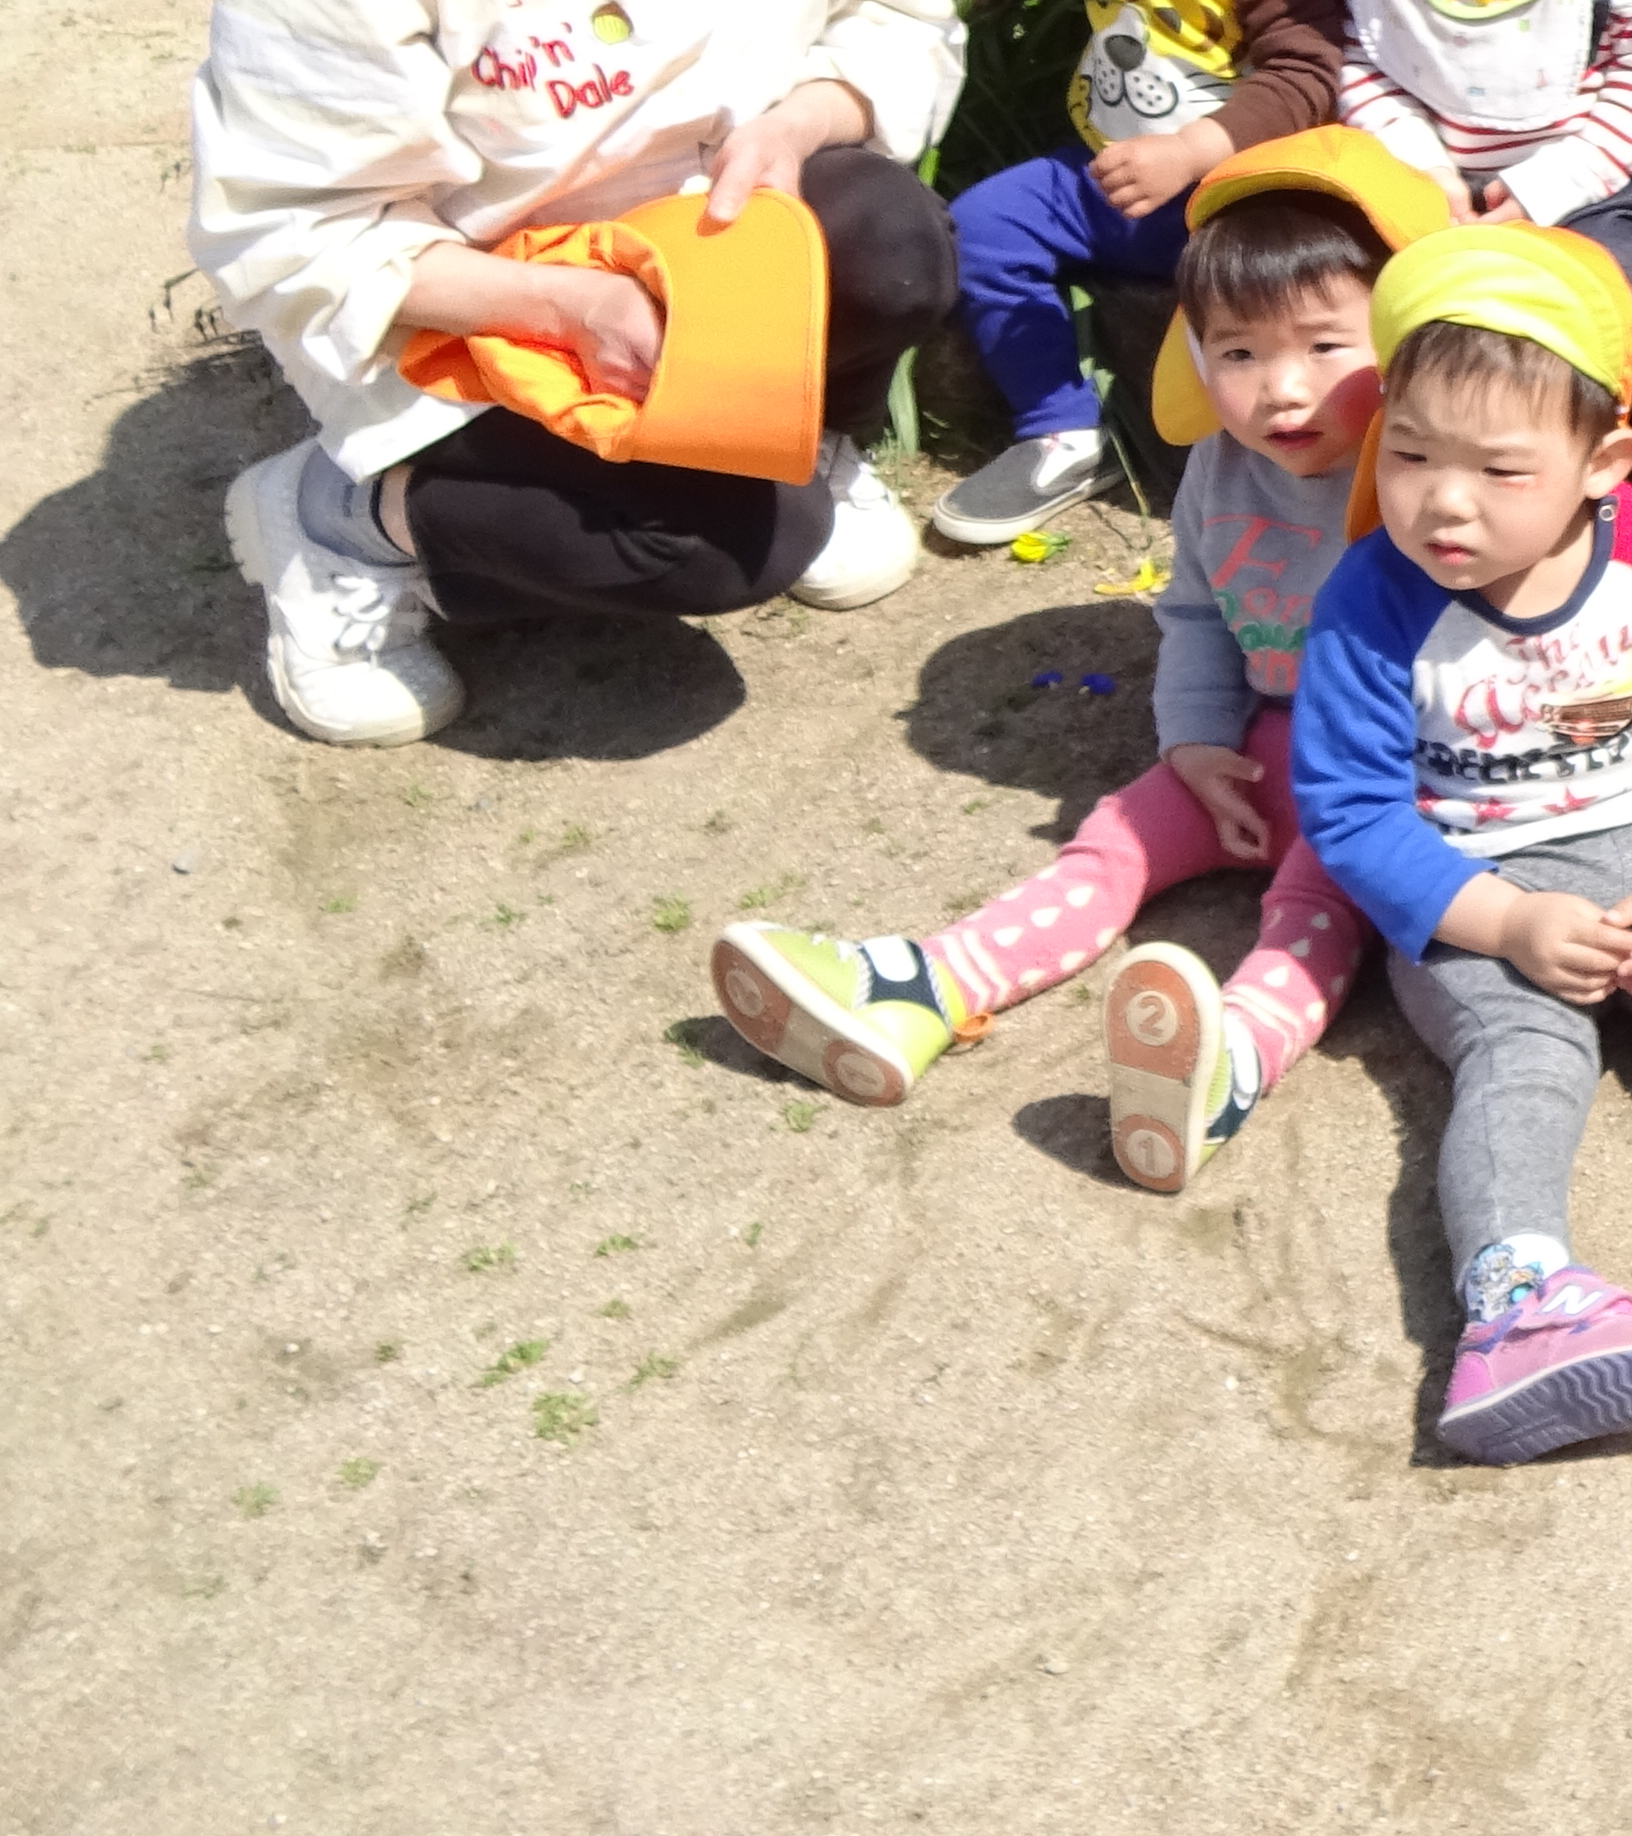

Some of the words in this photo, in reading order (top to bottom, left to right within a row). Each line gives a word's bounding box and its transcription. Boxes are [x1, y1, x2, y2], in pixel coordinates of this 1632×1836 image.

[545, 63, 634, 120] Dale
[1138, 994, 1166, 1038] 2
[1537, 1282, 1606, 1316] N
